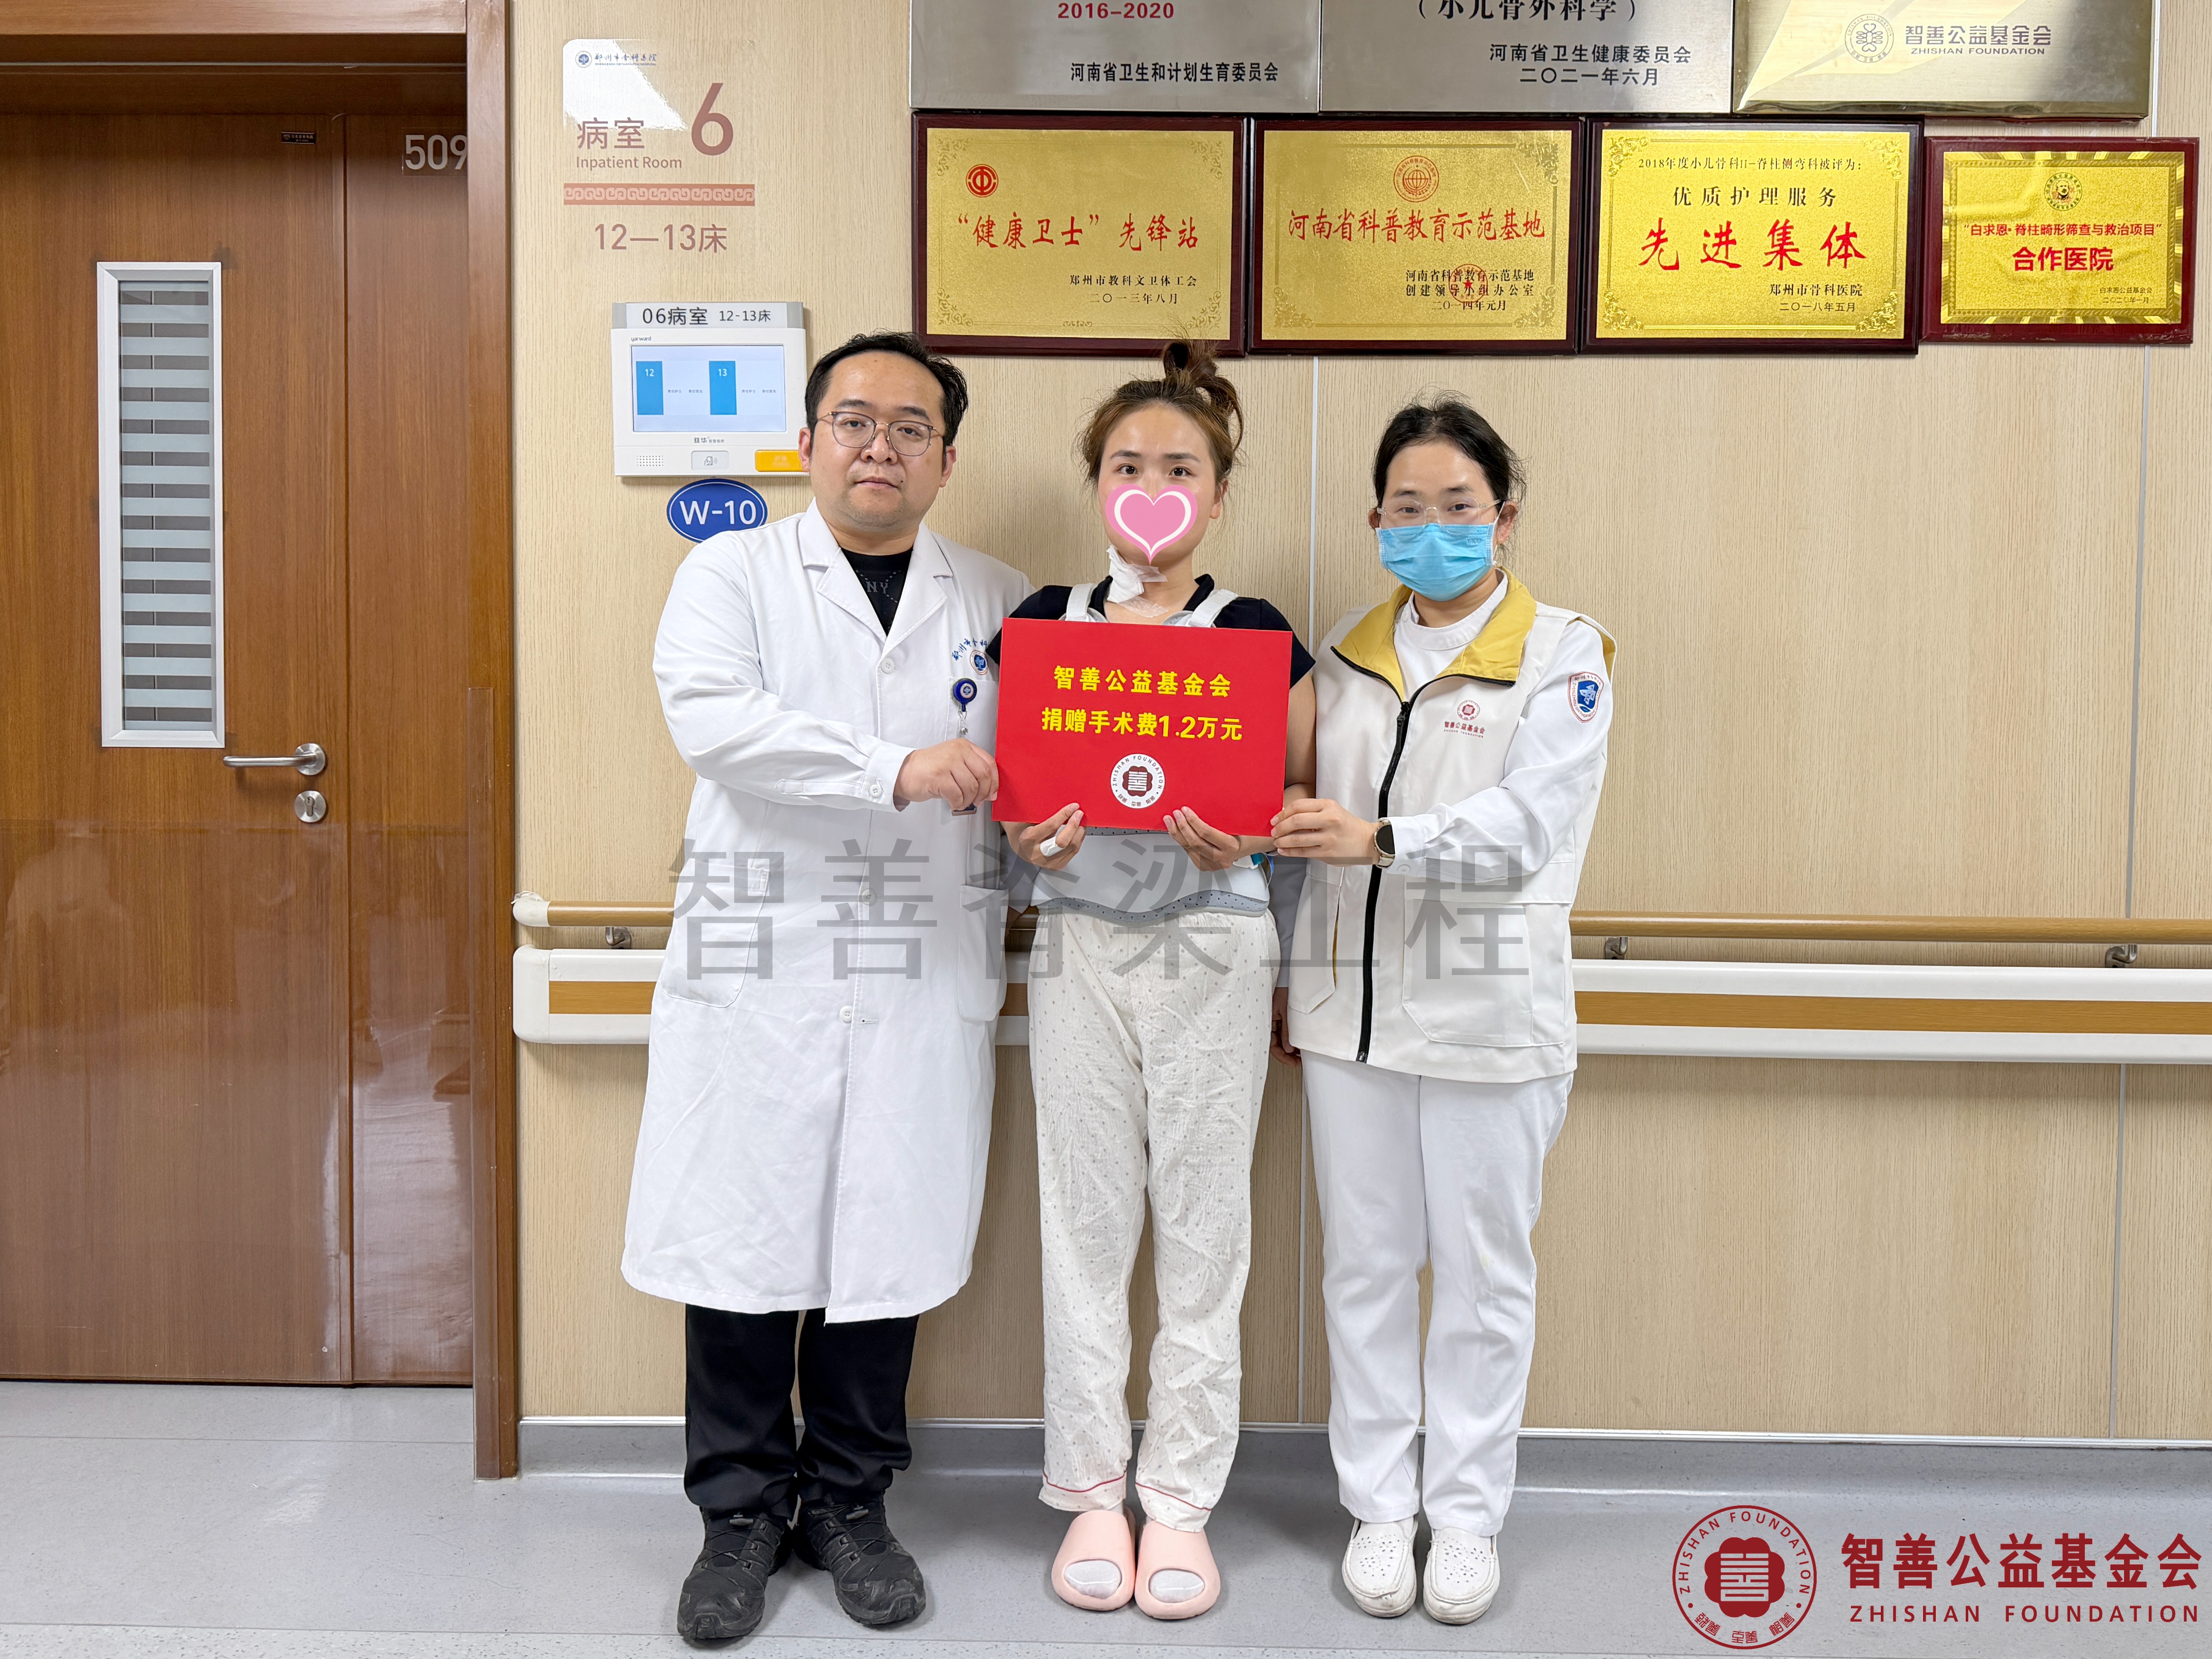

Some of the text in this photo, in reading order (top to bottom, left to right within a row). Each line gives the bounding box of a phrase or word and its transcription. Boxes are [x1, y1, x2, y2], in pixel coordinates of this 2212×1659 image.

[1905, 25, 2052, 46] 智善公益基金会
[1489, 44, 1692, 63] 河南省卫生健康委员会
[1071, 62, 1279, 83] 河南省卫生和计划生育委员会
[691, 82, 734, 156] 6
[577, 117, 645, 149] 病室
[405, 134, 468, 170] 509
[576, 156, 682, 171] Inpatient Room
[1673, 186, 1837, 208] 优质护理服务
[1119, 213, 1199, 252] 先锋站
[1288, 207, 1545, 243] 河南省科普教育示范基地
[1639, 217, 1867, 271] 先进集体
[2012, 246, 2114, 271] 合作医院
[1070, 275, 1197, 287] 郑州市教科文卫体工会
[1405, 269, 1535, 283] 河南省科普教育示范基地
[1406, 284, 1534, 297] 创建领导小组办公室
[1769, 283, 1863, 297] 郑州市骨科医院
[642, 307, 771, 326] 06病室 12-13床
[645, 369, 654, 377] 12
[679, 500, 756, 525] W-10
[1053, 665, 1231, 698] 智善公益基金会
[1041, 707, 1243, 741] 捐赠手术费1.2万元
[1112, 755, 1163, 789] ZHISHAN FOUNDATION
